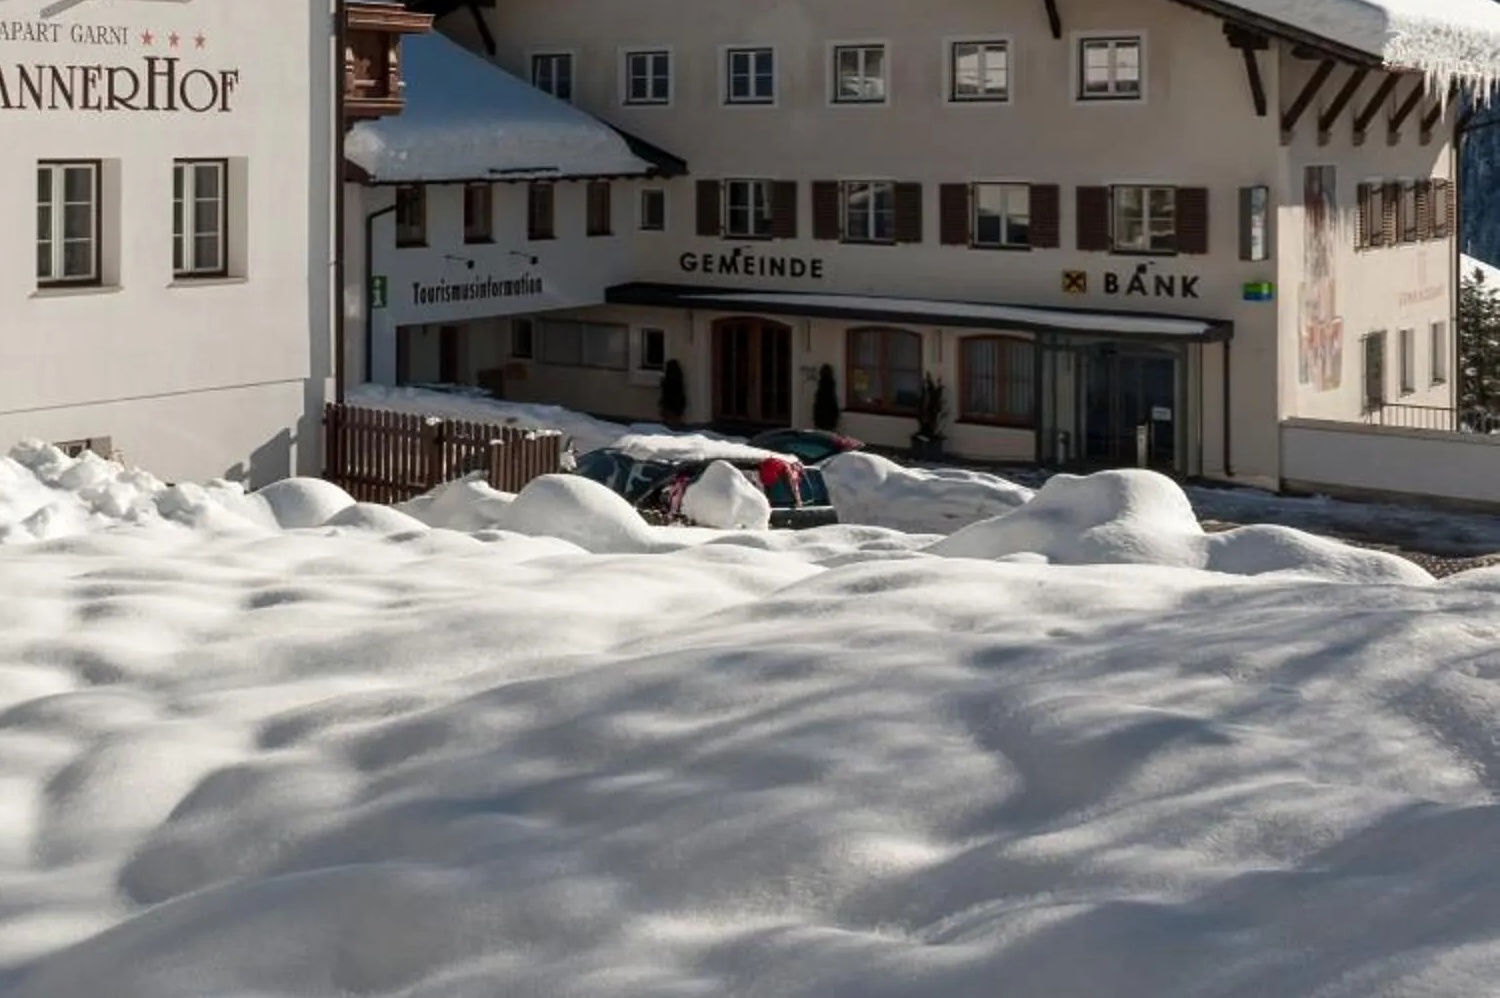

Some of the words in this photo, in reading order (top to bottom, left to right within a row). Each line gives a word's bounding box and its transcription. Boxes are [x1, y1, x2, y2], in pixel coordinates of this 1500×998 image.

[70, 24, 129, 46] GARNI
[679, 252, 823, 279] GEMEINDE
[412, 272, 544, 305] Tourismusinformation
[1104, 271, 1200, 298] BANK
